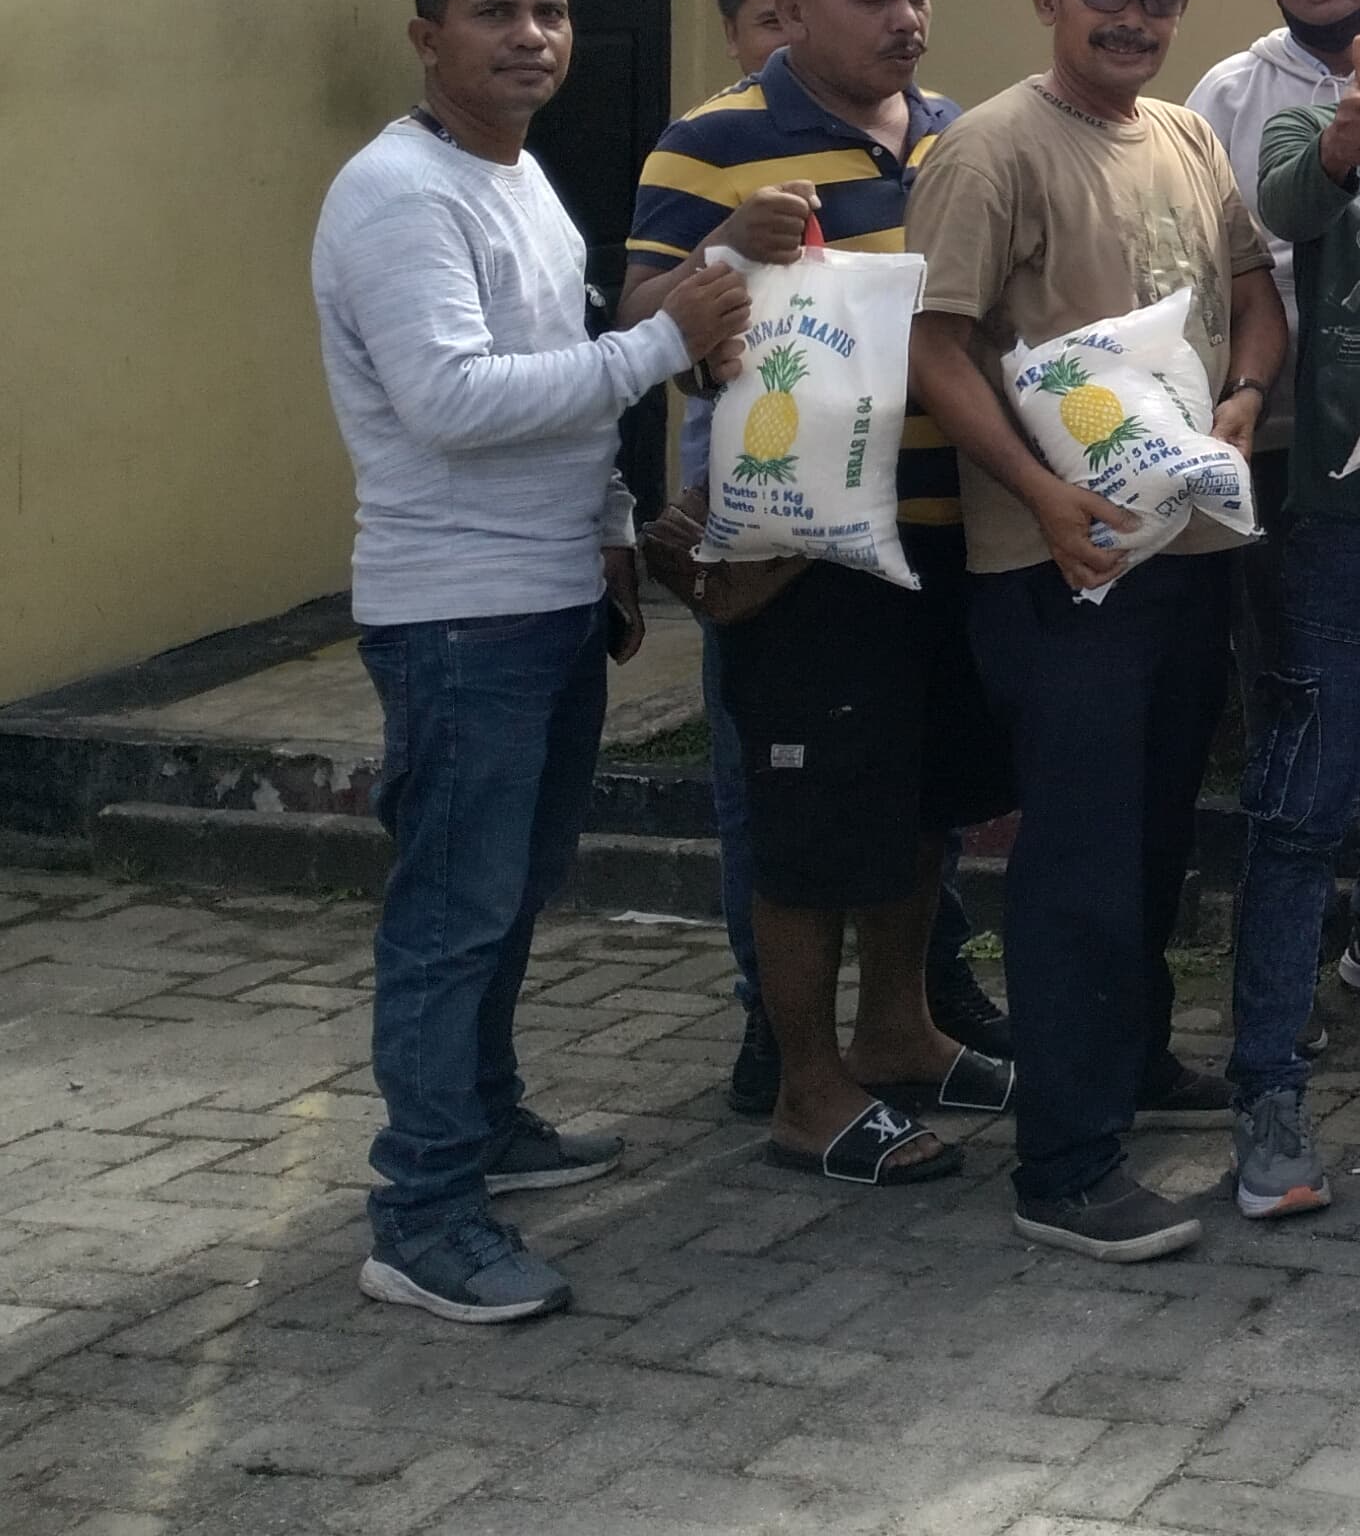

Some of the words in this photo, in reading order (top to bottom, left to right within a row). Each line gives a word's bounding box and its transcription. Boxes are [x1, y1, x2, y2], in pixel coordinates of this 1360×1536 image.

[745, 315, 793, 352] NENAS
[798, 315, 856, 358] MANIS
[854, 417, 870, 435] IR
